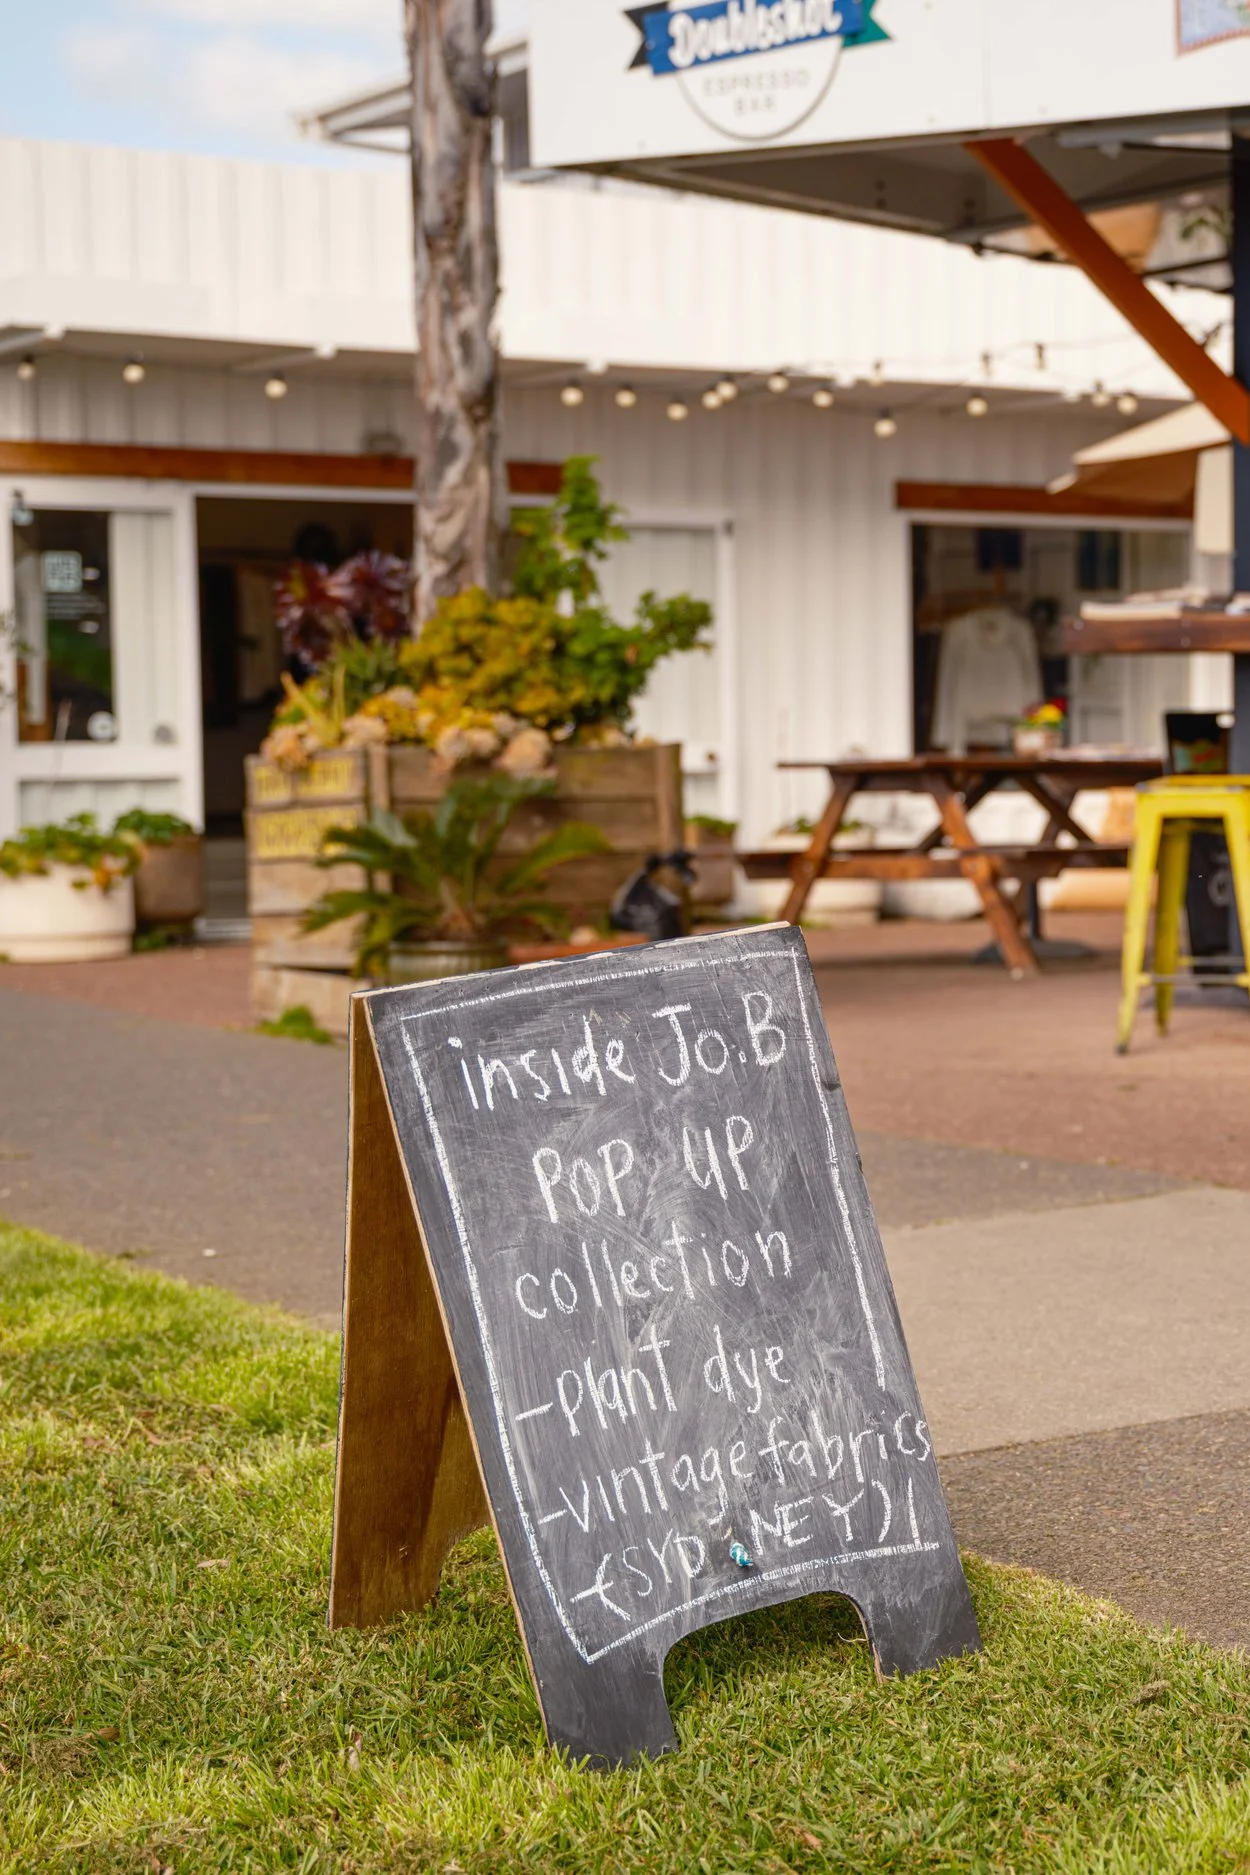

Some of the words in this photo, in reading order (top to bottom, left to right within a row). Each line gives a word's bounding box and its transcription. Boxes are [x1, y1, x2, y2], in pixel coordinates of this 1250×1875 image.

[668, 0, 843, 68] Doubleshot
[447, 1013, 635, 1111] inside
[515, 1220, 793, 1320] collection
[704, 1324, 791, 1413] dye
